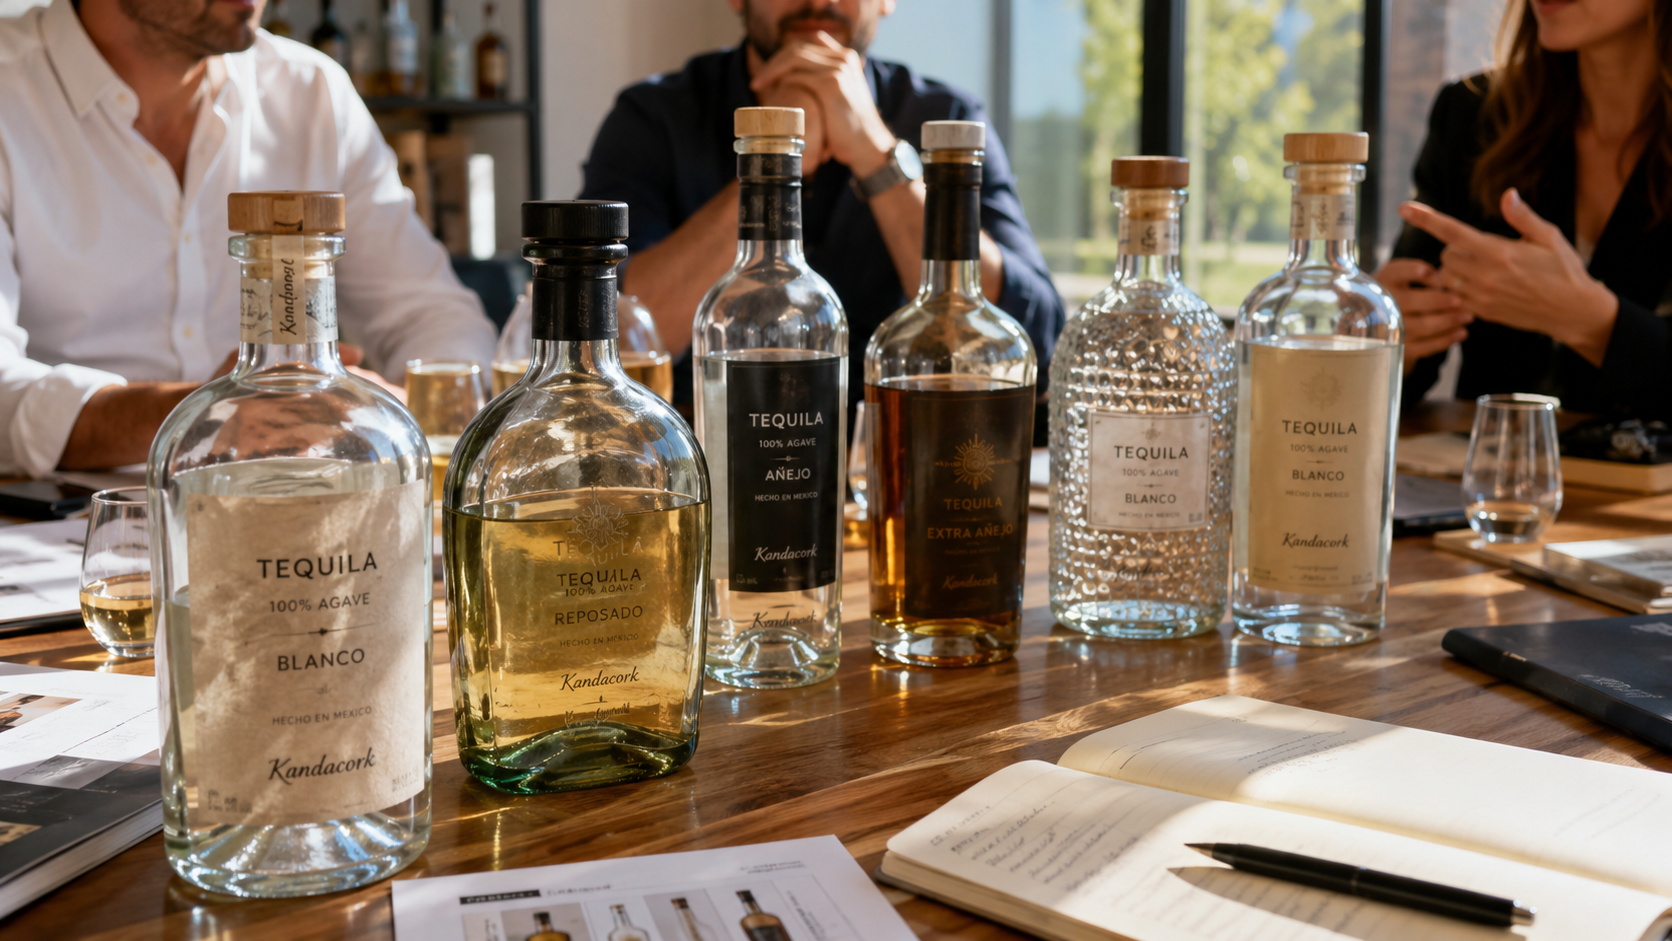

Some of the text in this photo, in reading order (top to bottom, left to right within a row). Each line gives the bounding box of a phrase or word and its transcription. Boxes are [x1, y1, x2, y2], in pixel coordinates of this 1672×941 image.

[748, 411, 824, 429] TEQUILA
[1282, 419, 1358, 436] TEQUILA
[759, 437, 817, 449] 100% AGAVE
[1290, 443, 1349, 454] 100% AGAVE
[1113, 445, 1189, 461] TEQUILA
[764, 466, 811, 481] AÑEJO
[1122, 468, 1180, 478] 100% AGAVE
[1292, 469, 1345, 482] BLANCO
[754, 493, 780, 502] HECHO
[781, 493, 792, 501] EN
[943, 496, 1003, 512] TEQUILA
[1125, 493, 1177, 504] BLANCO
[927, 522, 1014, 540] EXTRA AÑEJO
[1282, 532, 1349, 549] Kandacork
[754, 543, 818, 562] Kandacork
[256, 551, 378, 580] TEQUILA
[556, 568, 642, 587] TEQUILA
[269, 592, 371, 613] 100% AGAVE
[555, 605, 643, 625] REPOSADO
[560, 638, 591, 648] HECHO
[277, 648, 365, 671] BLANCO
[559, 666, 640, 691] Kandacork
[272, 705, 373, 726] HECHO EN MEXICO
[268, 747, 376, 785] Kandacork
